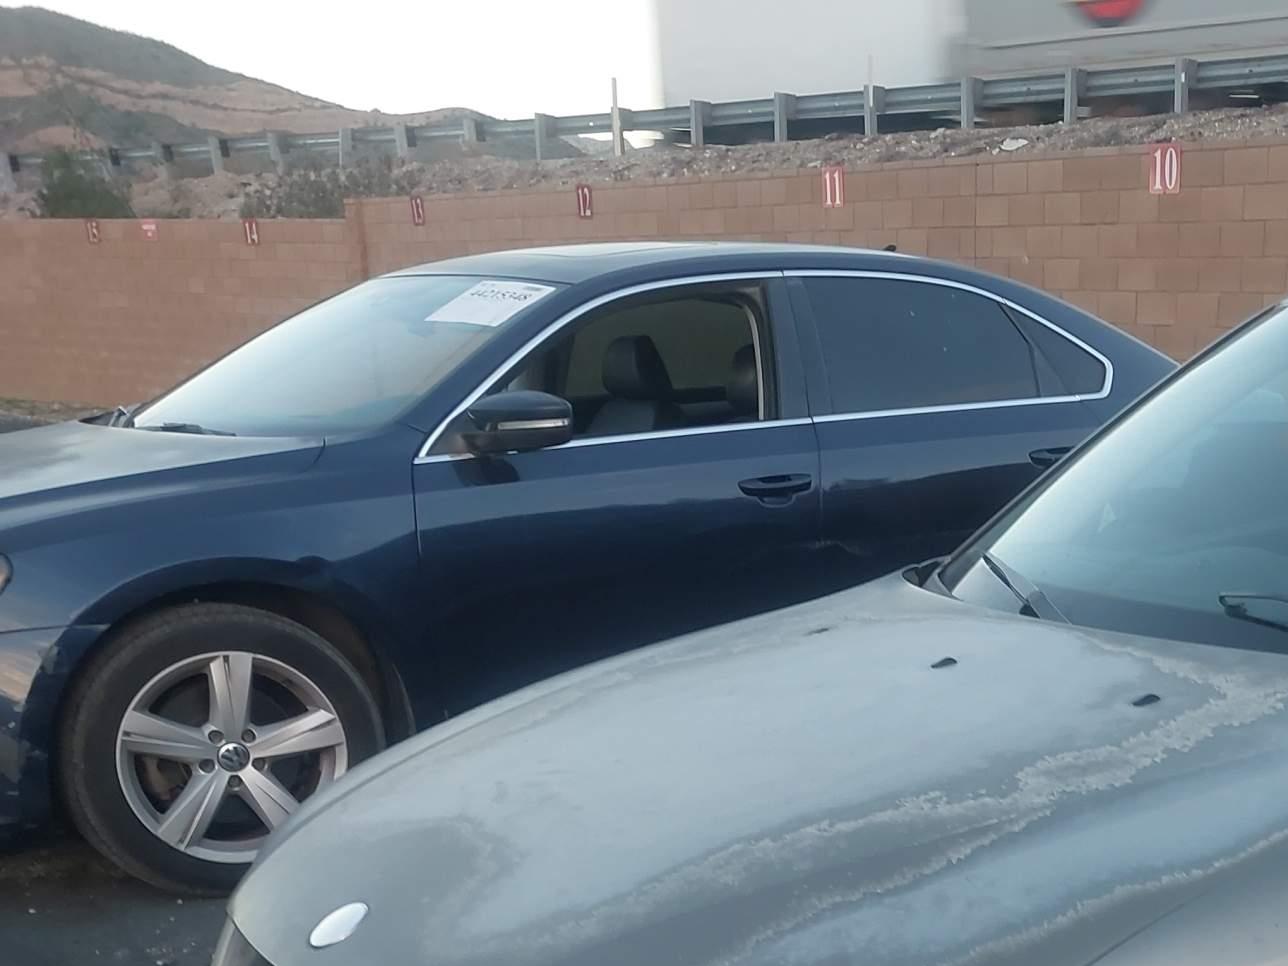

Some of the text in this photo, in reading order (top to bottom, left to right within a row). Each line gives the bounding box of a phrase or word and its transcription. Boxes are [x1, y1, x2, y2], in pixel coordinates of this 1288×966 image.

[1153, 147, 1178, 190] 10
[577, 186, 592, 217] 12
[825, 169, 841, 205] 11
[244, 220, 259, 245] 14
